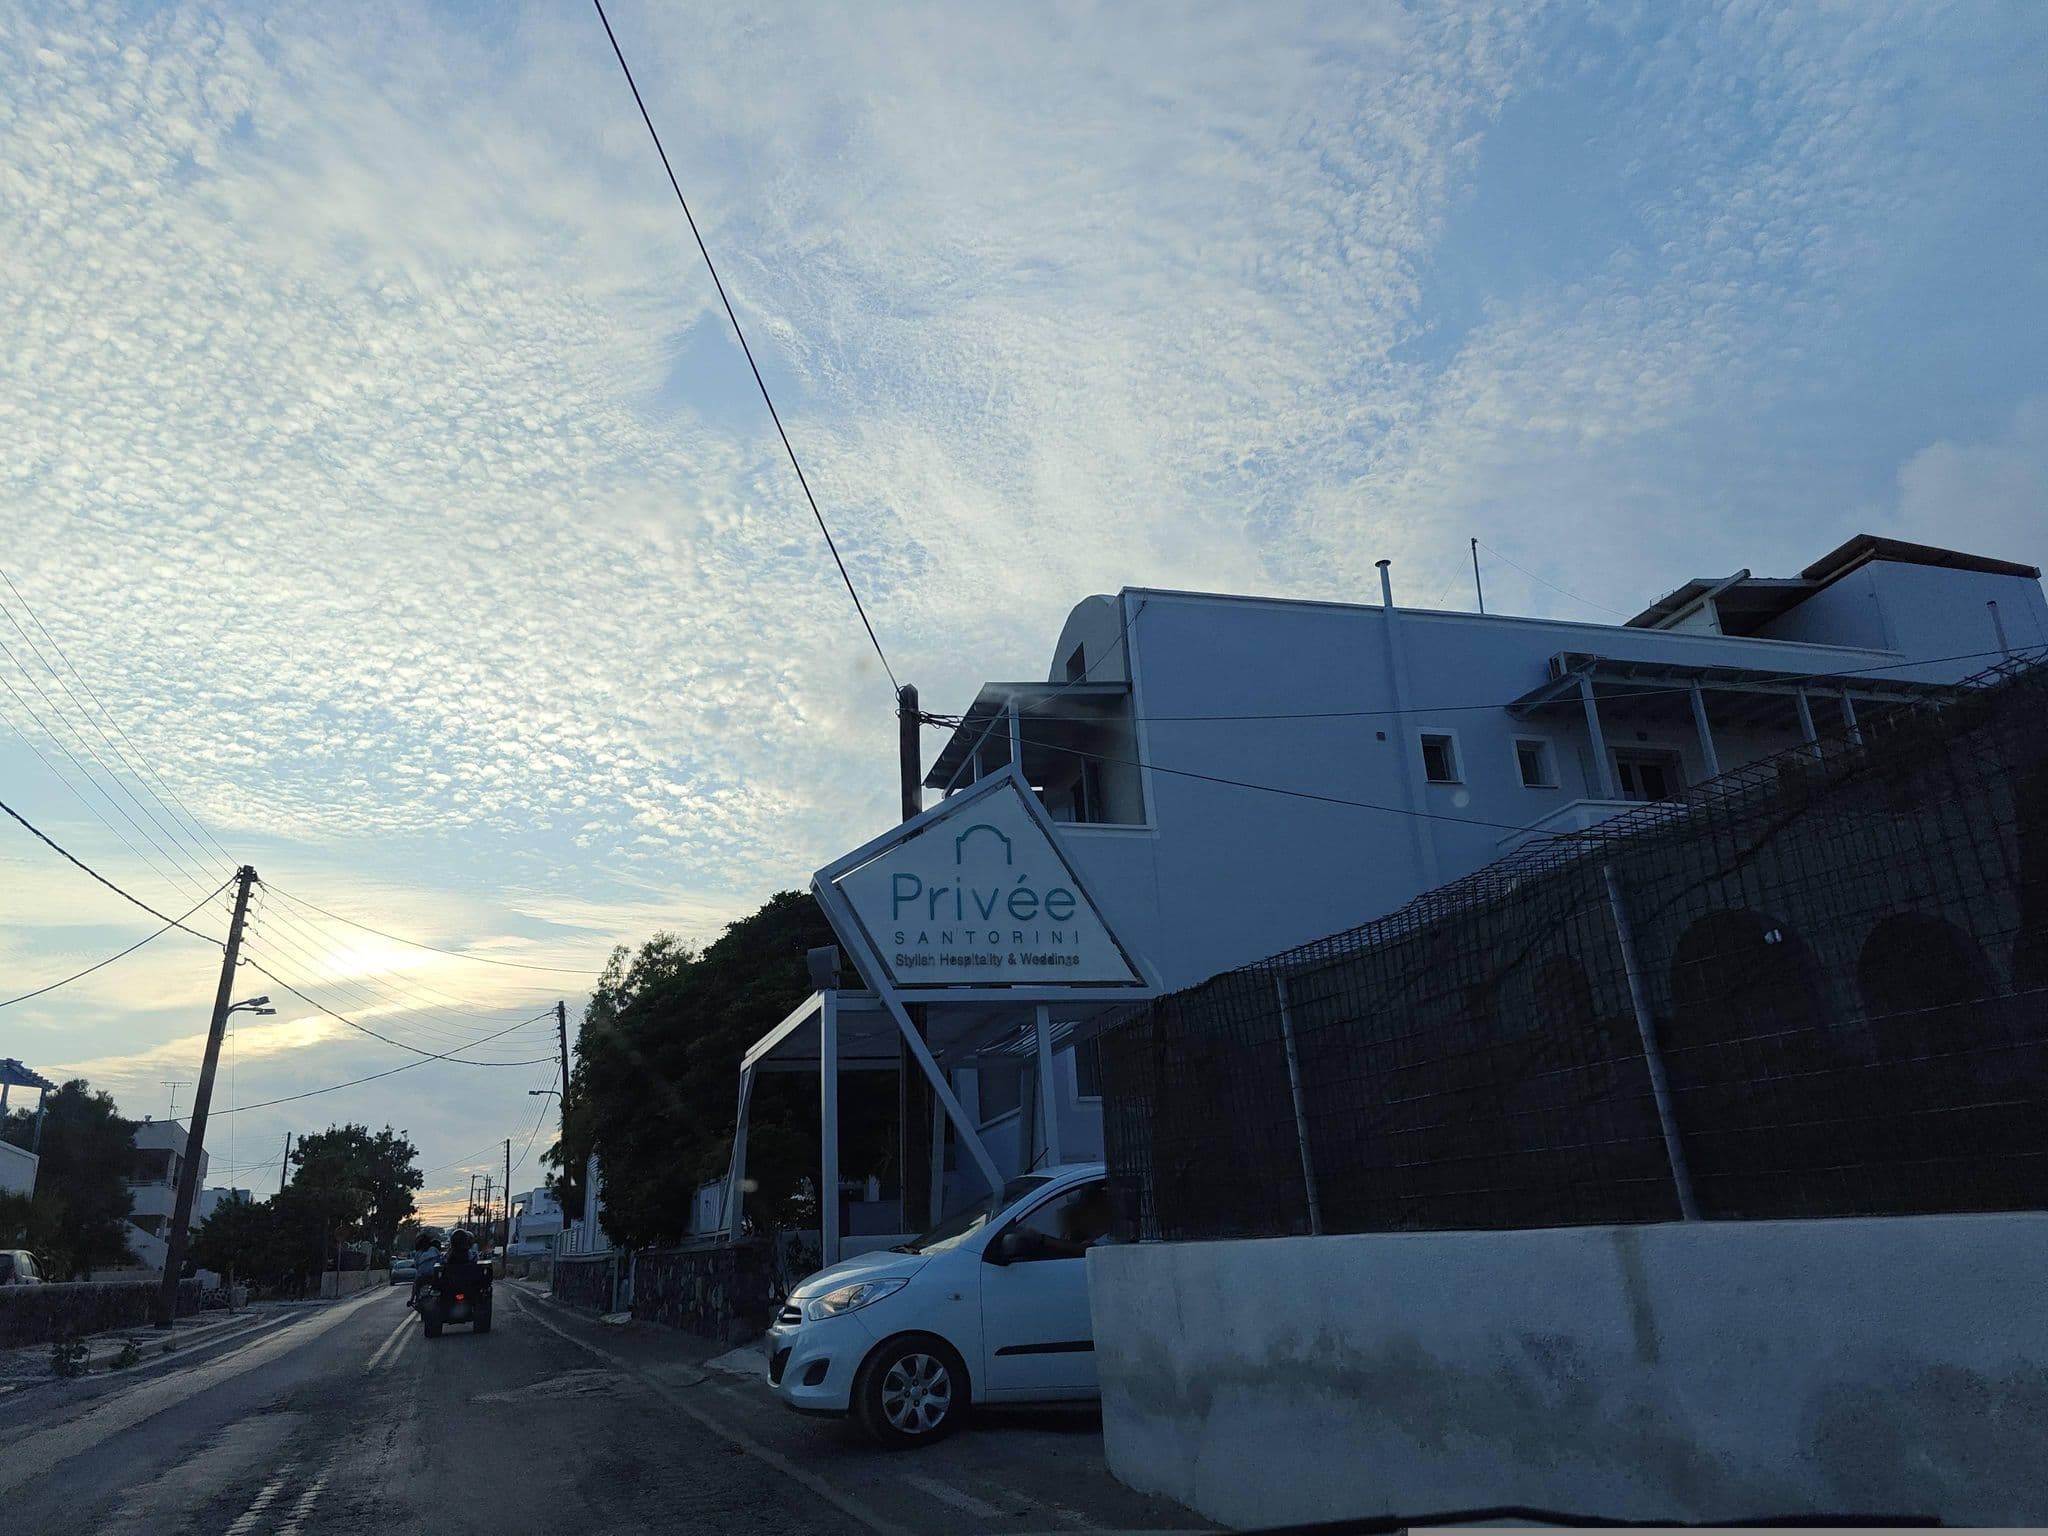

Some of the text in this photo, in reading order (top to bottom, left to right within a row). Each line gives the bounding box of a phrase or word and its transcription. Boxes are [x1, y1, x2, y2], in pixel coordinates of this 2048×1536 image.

[893, 873, 1076, 921] Privée
[894, 930, 1079, 944] SANTORINI
[896, 952, 1080, 967] Stylish Hospitality & Weddings
